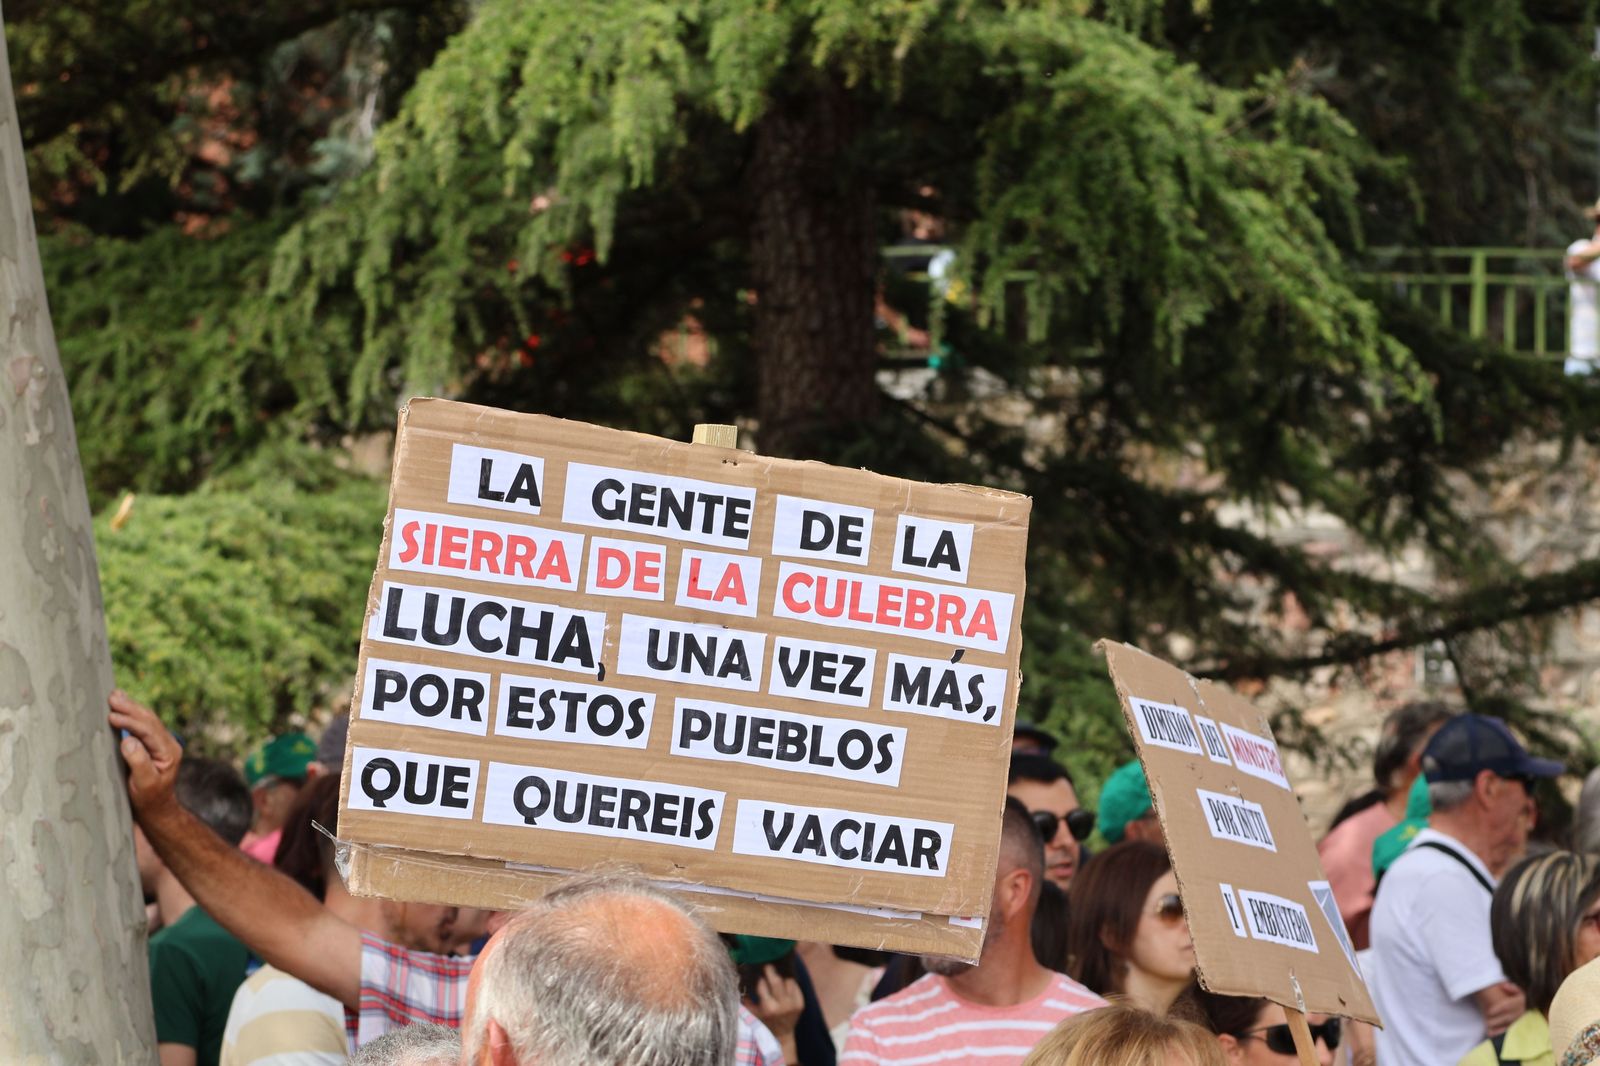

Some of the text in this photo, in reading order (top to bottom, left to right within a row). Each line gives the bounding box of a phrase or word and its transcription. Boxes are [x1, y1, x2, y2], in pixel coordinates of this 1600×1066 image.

[477, 458, 961, 572] LA GENTE DE LA
[398, 521, 999, 641] SIERRA DE LA CULEBRA
[383, 587, 997, 722] LUCHA, UNA VEZ MÁS,
[372, 668, 894, 774] POR ESTOS PUEBLOS
[1200, 723, 1228, 759] DEL
[361, 757, 942, 871] QUE QUEREIS VACIAR
[1207, 797, 1241, 836] POR
[1223, 893, 1314, 946] Y EMBUSTERO
